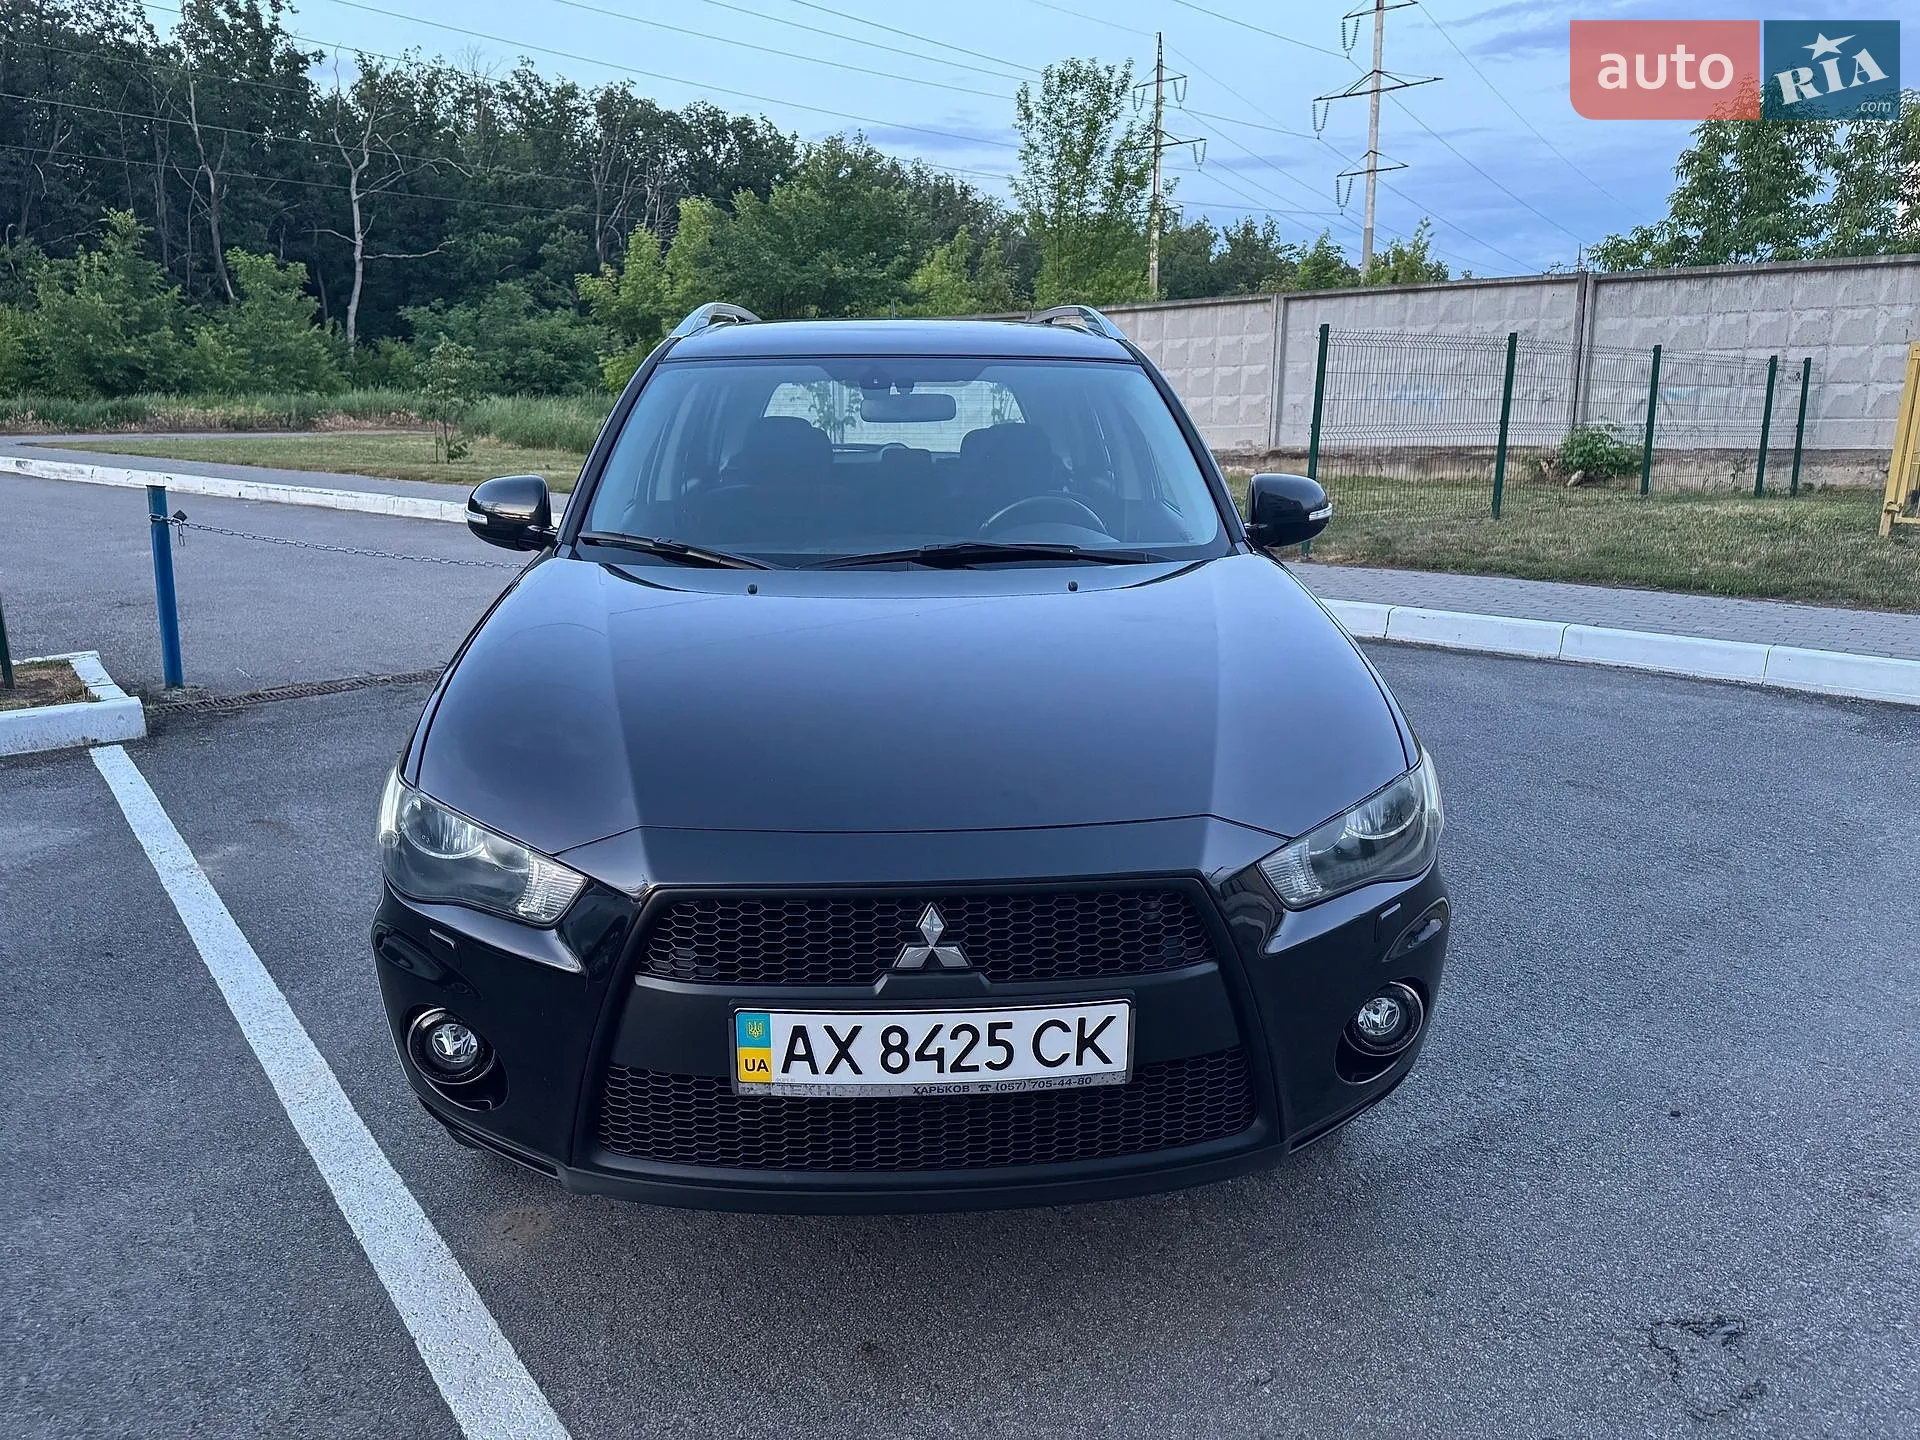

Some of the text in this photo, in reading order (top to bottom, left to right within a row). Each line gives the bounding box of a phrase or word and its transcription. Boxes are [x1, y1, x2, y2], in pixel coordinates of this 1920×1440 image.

[781, 1015, 1117, 1075] AX 8425 CK
[744, 1059, 769, 1073] UA
[912, 1076, 1092, 1095] ХАРЬКОВ (057) 705-44-80
